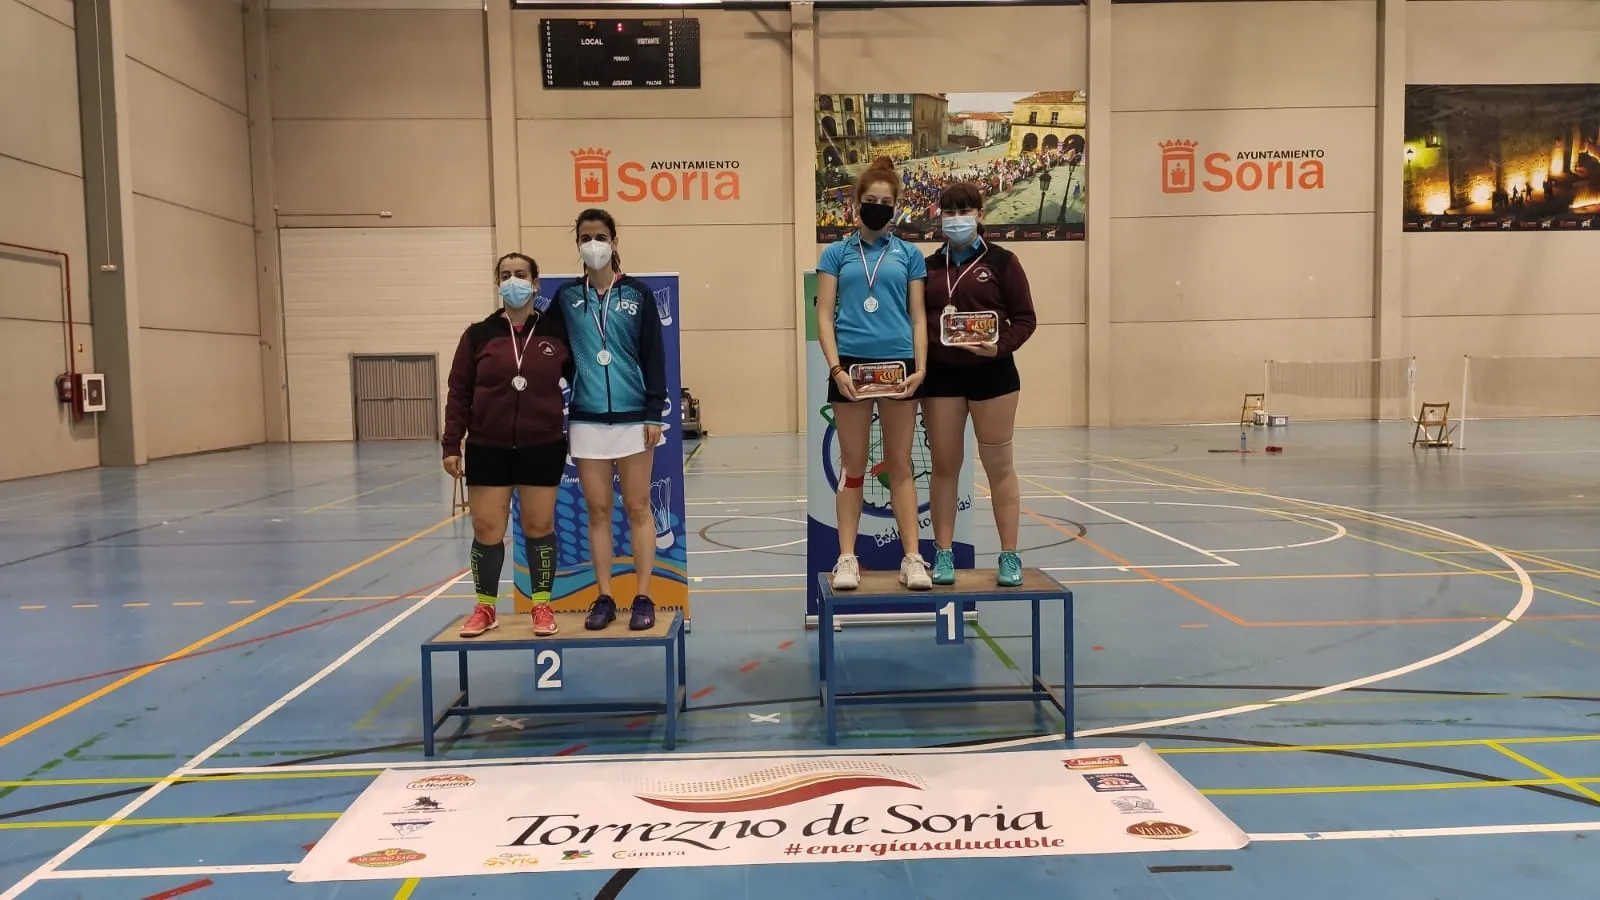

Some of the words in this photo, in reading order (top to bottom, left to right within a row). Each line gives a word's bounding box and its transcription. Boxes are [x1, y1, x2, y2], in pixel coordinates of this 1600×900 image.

[580, 38, 604, 46] LOCAL
[650, 160, 740, 170] AYUNTAMIENTO
[1236, 149, 1325, 160] AYUNTAMIENTO
[616, 161, 741, 202] Soria
[1202, 152, 1325, 193] Soria
[939, 601, 956, 640] 1
[536, 649, 562, 689] 2
[496, 813, 787, 851] Torrezno
[802, 803, 870, 837] de
[881, 803, 1053, 834] Soria
[1135, 825, 1182, 836] VILLAR
[784, 836, 1065, 856] #energíasaludable
